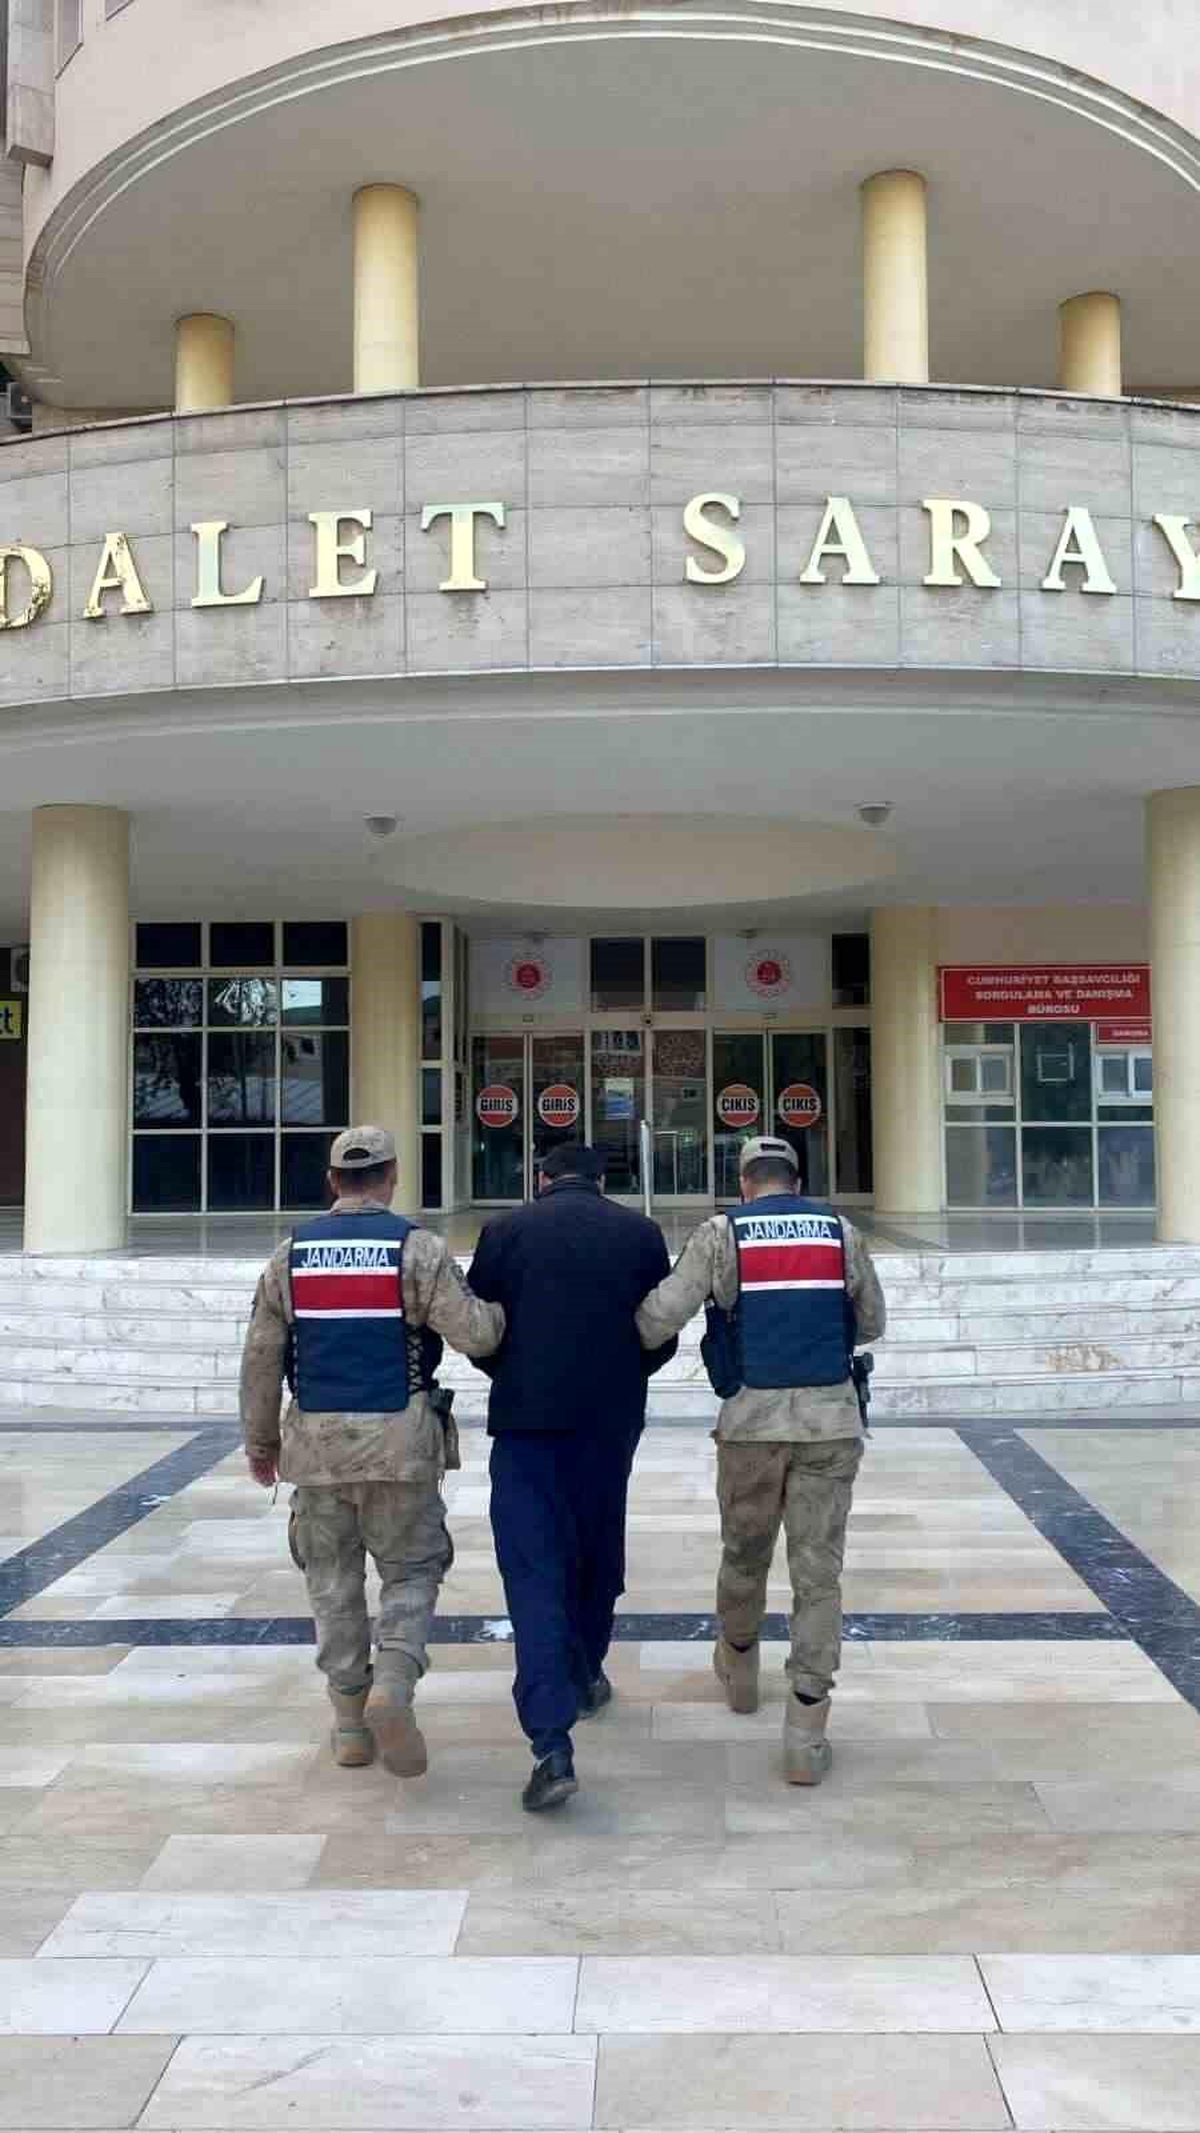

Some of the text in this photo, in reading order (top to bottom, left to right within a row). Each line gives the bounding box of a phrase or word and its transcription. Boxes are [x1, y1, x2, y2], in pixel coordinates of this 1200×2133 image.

[1056, 990, 1073, 999] VE
[745, 1220, 832, 1240] JANDARMA
[300, 1247, 390, 1268] JANDARMA
